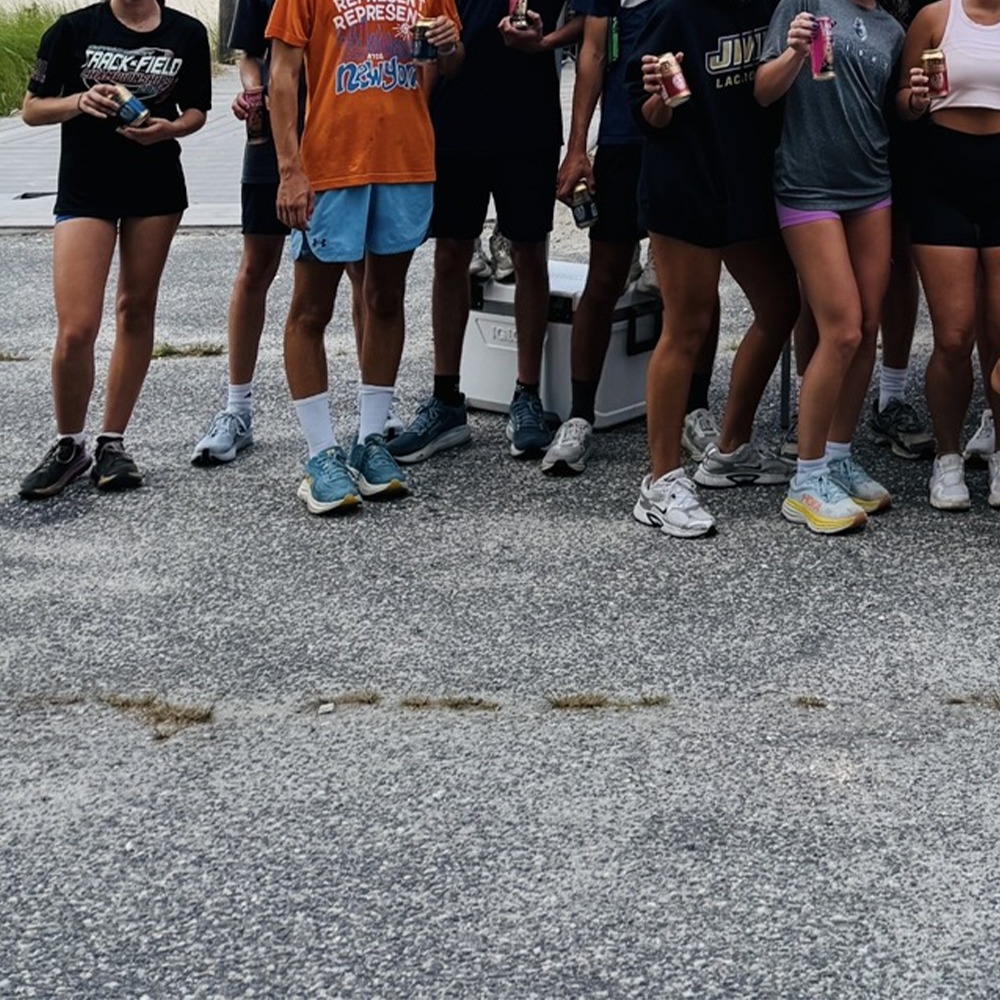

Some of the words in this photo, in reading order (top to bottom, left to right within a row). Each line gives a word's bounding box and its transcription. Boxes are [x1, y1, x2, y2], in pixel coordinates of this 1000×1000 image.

[332, 3, 424, 30] REPRESEN
[705, 26, 769, 74] JM
[715, 73, 756, 89] LACRO
